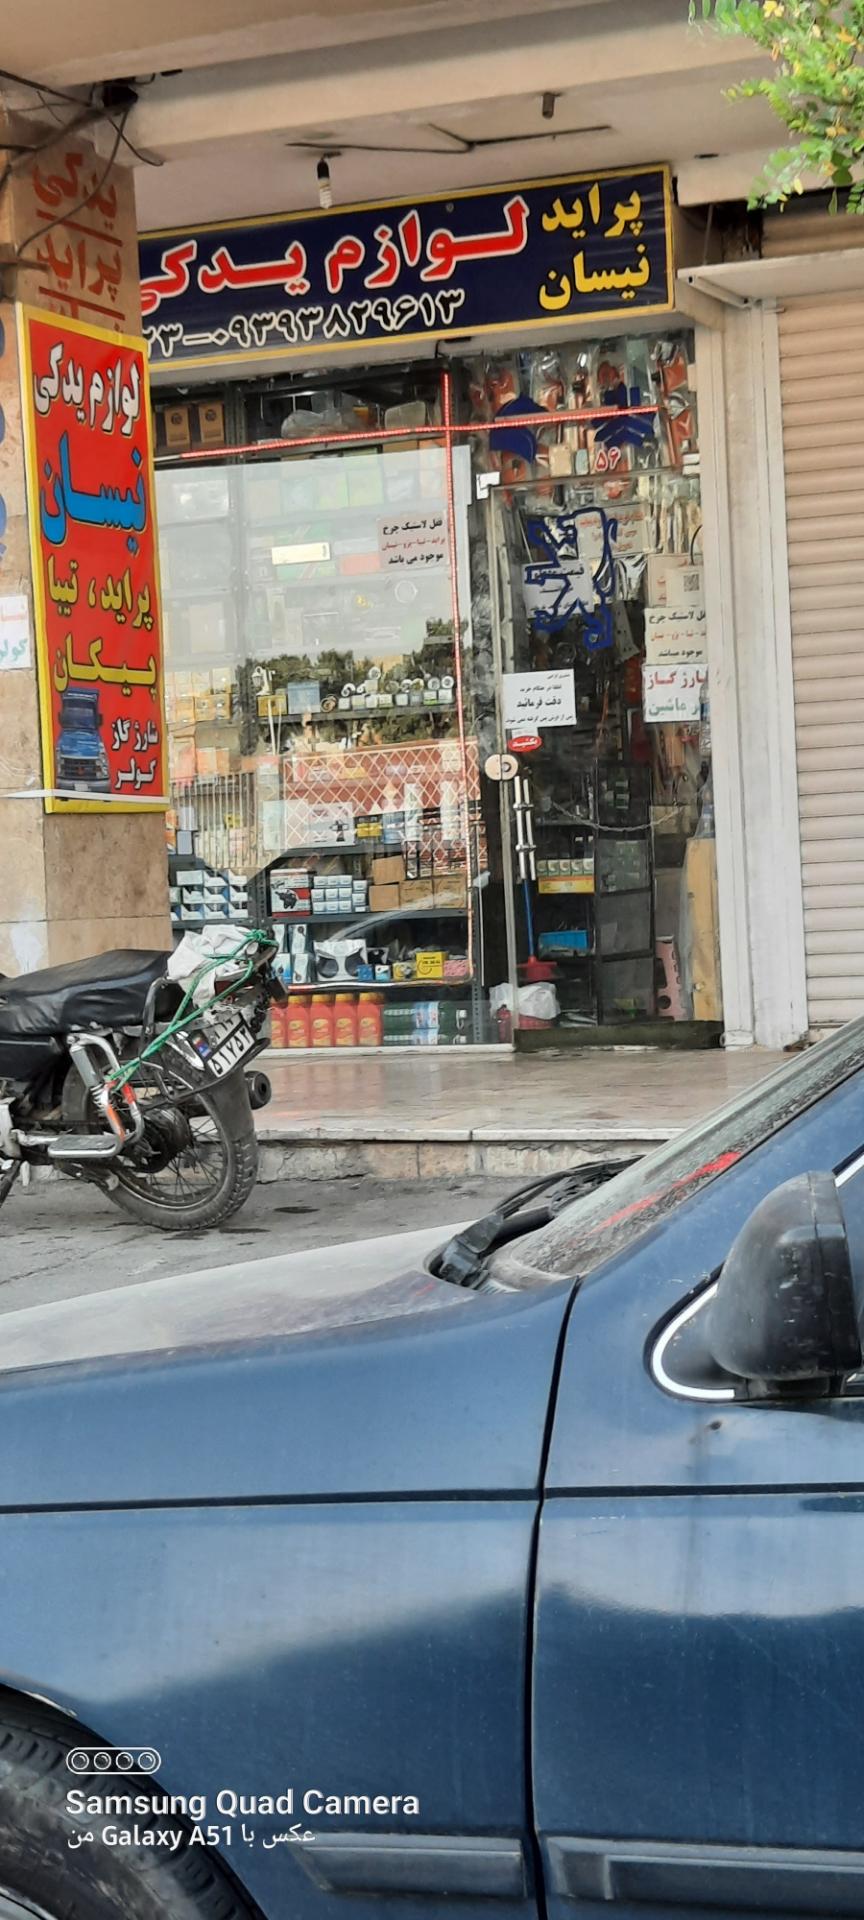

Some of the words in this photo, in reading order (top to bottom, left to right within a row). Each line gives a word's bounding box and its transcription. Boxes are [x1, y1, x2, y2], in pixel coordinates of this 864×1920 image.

[324, 195, 530, 293] لوازم
[541, 182, 644, 238] پراید
[36, 233, 123, 303] پراید
[538, 243, 652, 310] نیسان
[32, 340, 86, 424] یدکی
[88, 357, 141, 438] لوازم
[40, 429, 147, 556] نیسان
[47, 554, 79, 617] تیبا
[111, 717, 132, 751] گاز
[114, 757, 157, 790] کولر
